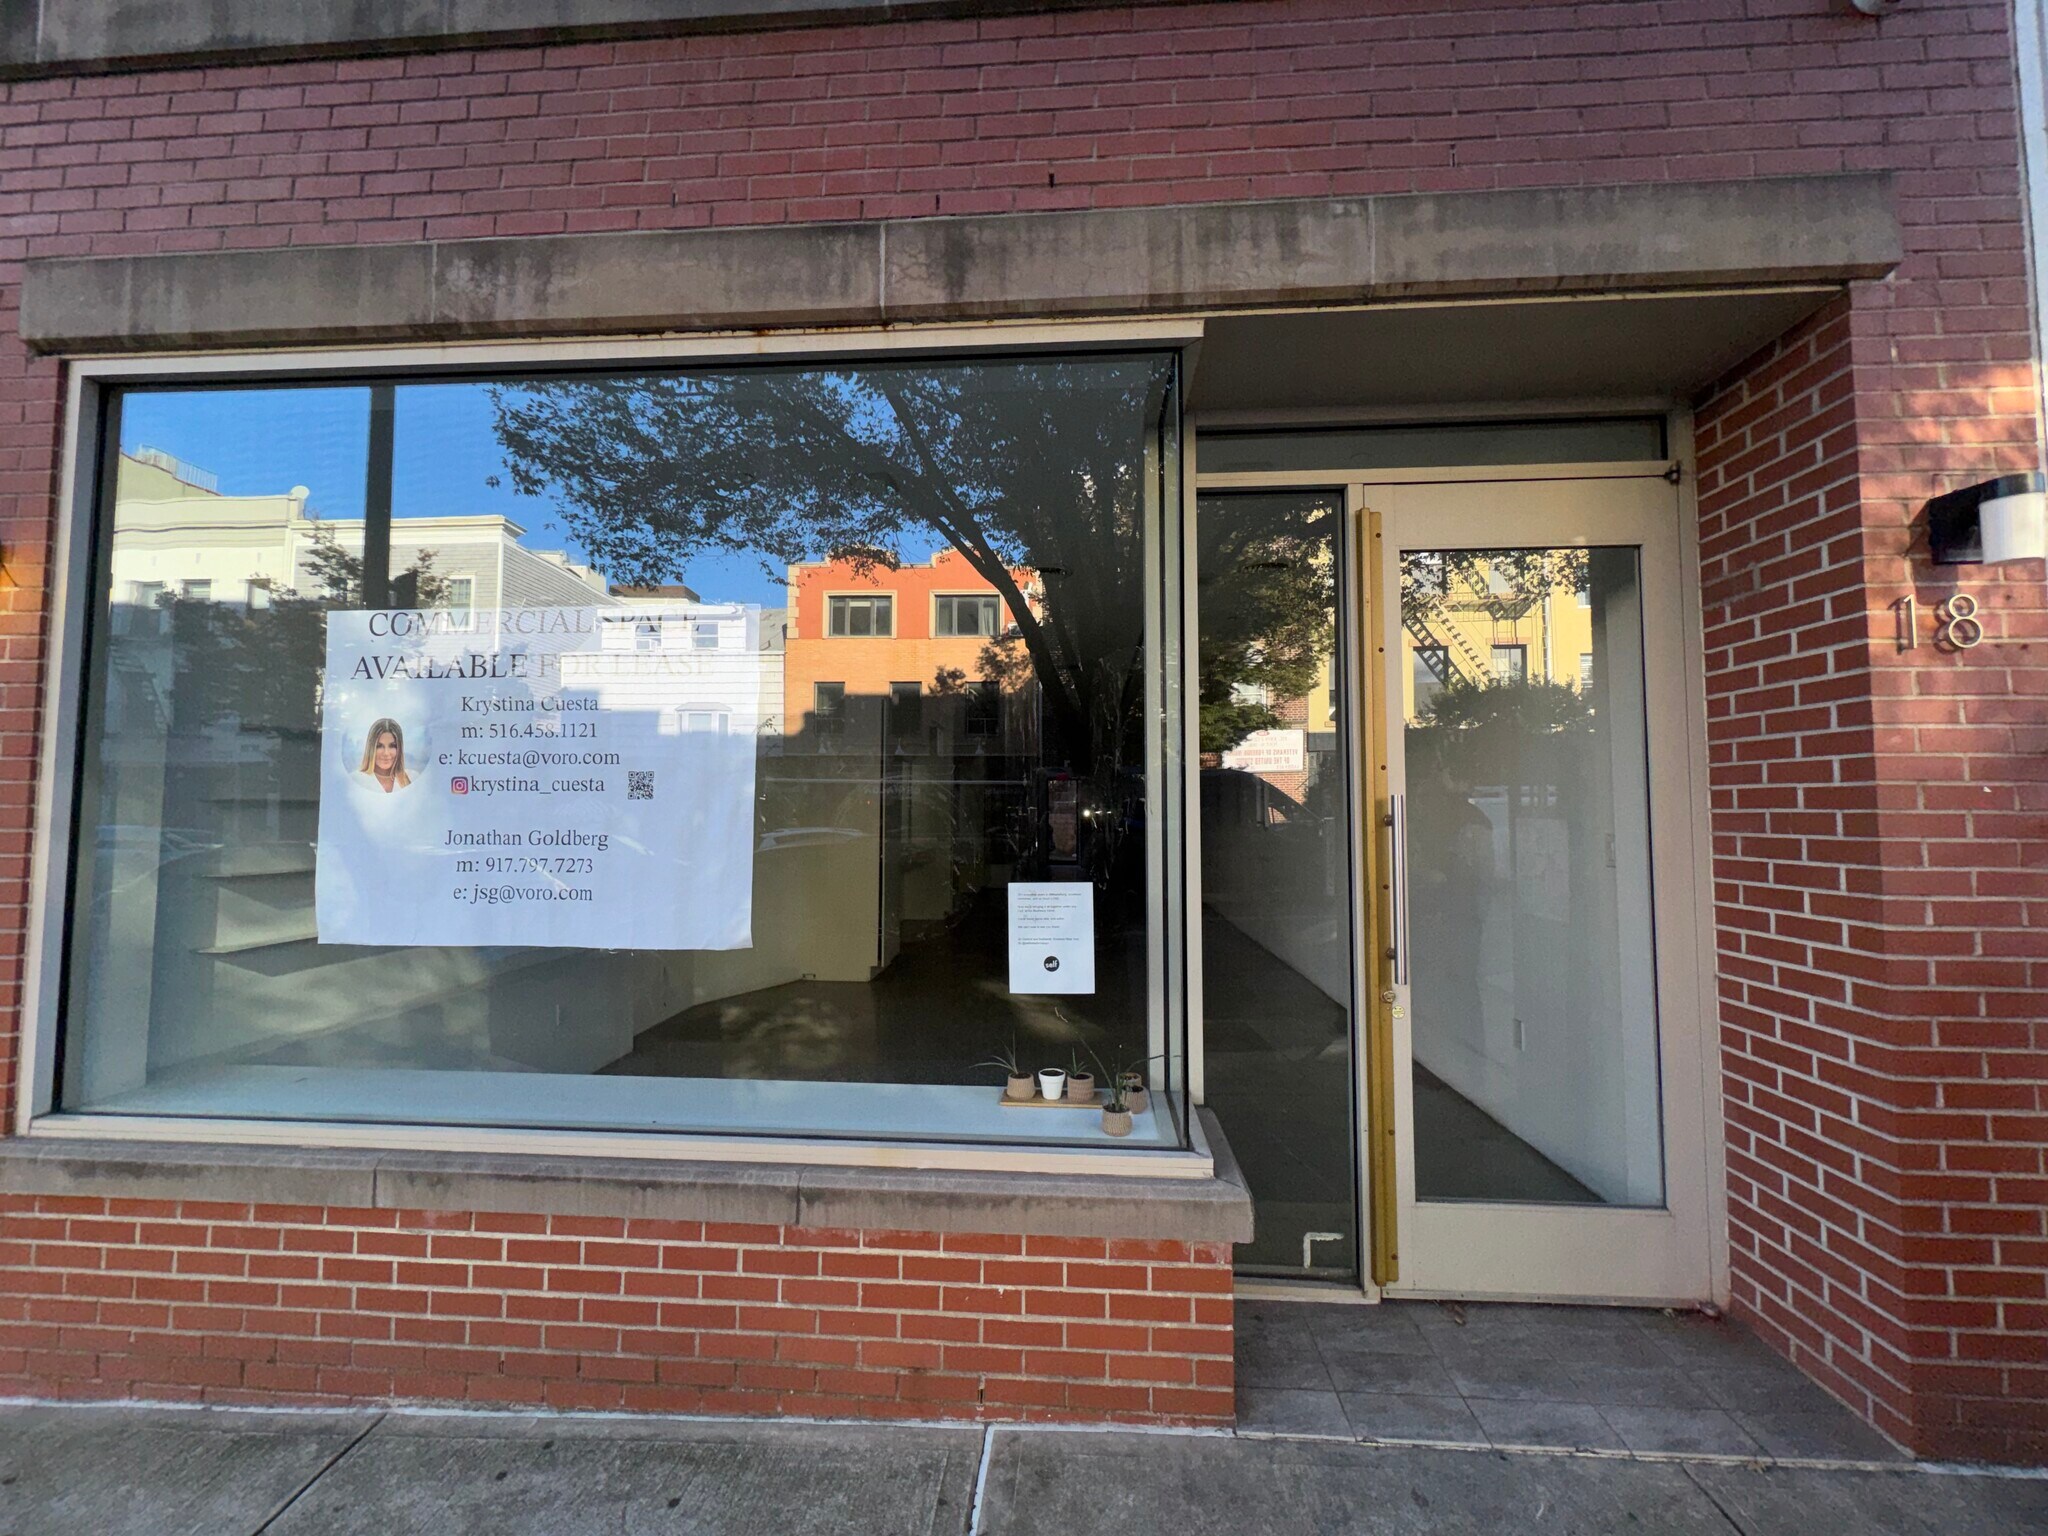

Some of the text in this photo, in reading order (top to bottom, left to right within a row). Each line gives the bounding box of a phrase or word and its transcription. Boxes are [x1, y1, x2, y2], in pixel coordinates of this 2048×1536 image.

[368, 607, 701, 637] COMMERCIAL SPACE
[1903, 593, 1984, 649] 18
[350, 652, 715, 680] AVAILABLE FOR LEASE
[460, 696, 600, 716] Krystina Cuesta
[461, 722, 598, 739] m: 516.458.1121
[438, 749, 621, 769] e: kcuesta@voro.com
[470, 775, 605, 797] krystina_cuesta
[444, 829, 609, 851] Jonathan Goldberg
[456, 857, 594, 874] m: 917.797.7273
[453, 883, 594, 905] e: jsg@voro.com
